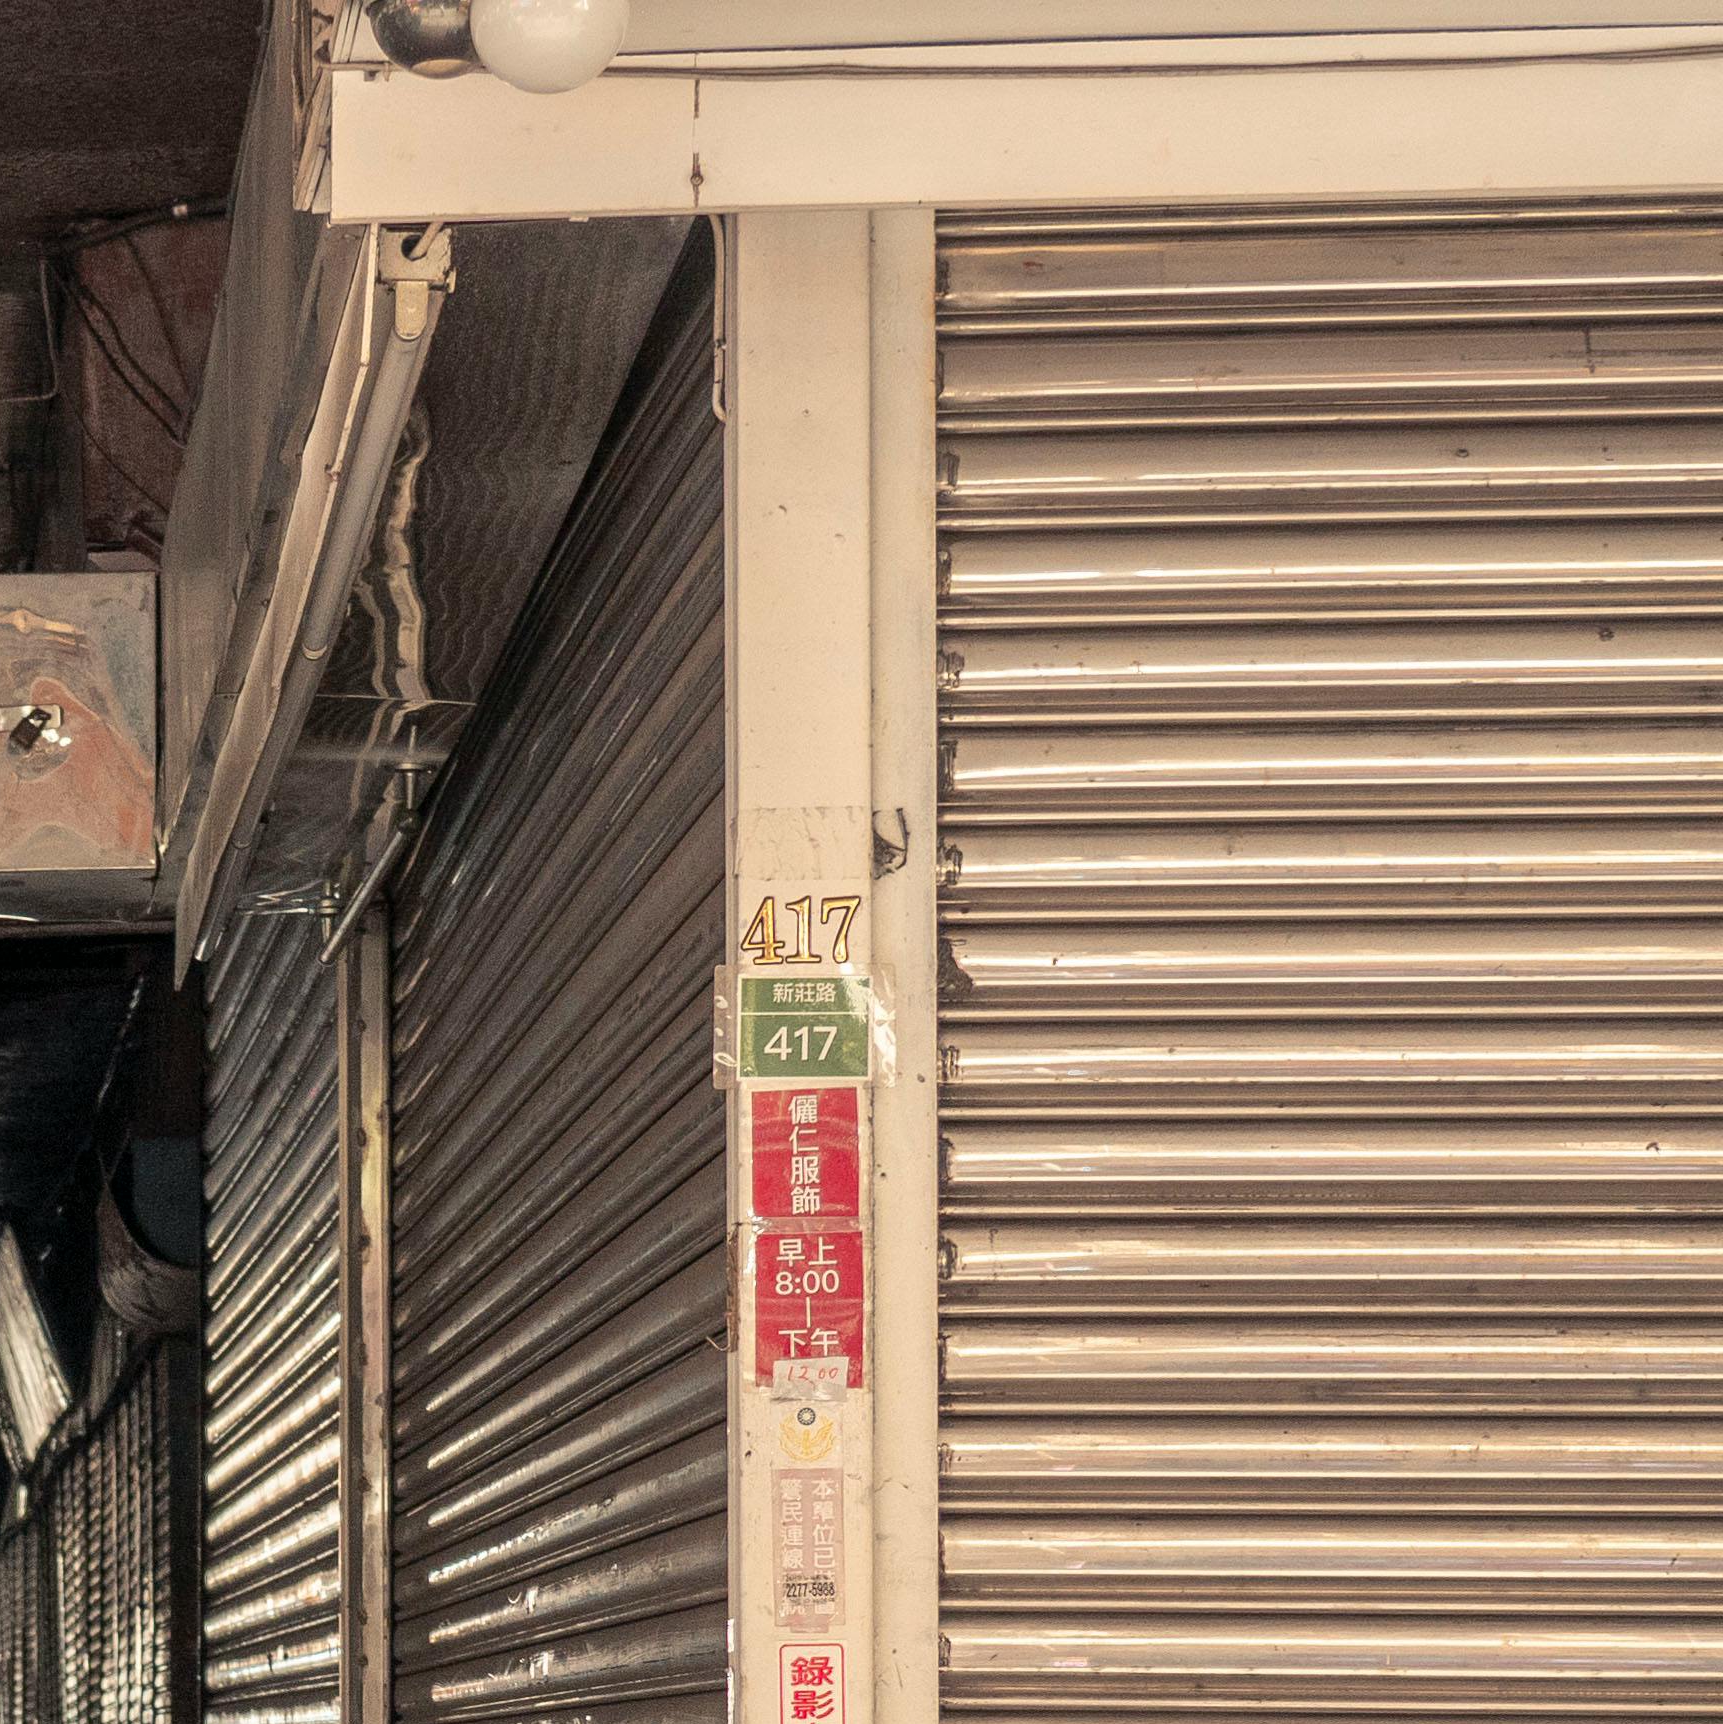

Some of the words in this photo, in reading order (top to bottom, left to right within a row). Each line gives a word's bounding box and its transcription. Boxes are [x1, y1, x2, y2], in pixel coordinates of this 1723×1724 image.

[740, 894, 862, 966] 417
[772, 981, 837, 1004] 新莊路
[763, 1025, 839, 1062] 417
[787, 1093, 822, 1216] 儷仁服飾
[775, 1237, 839, 1267] 早上
[774, 1269, 841, 1296] 8:00
[777, 1327, 840, 1358] 下午
[778, 1478, 805, 1616] 警民連線
[810, 1477, 837, 1616] 本單位已
